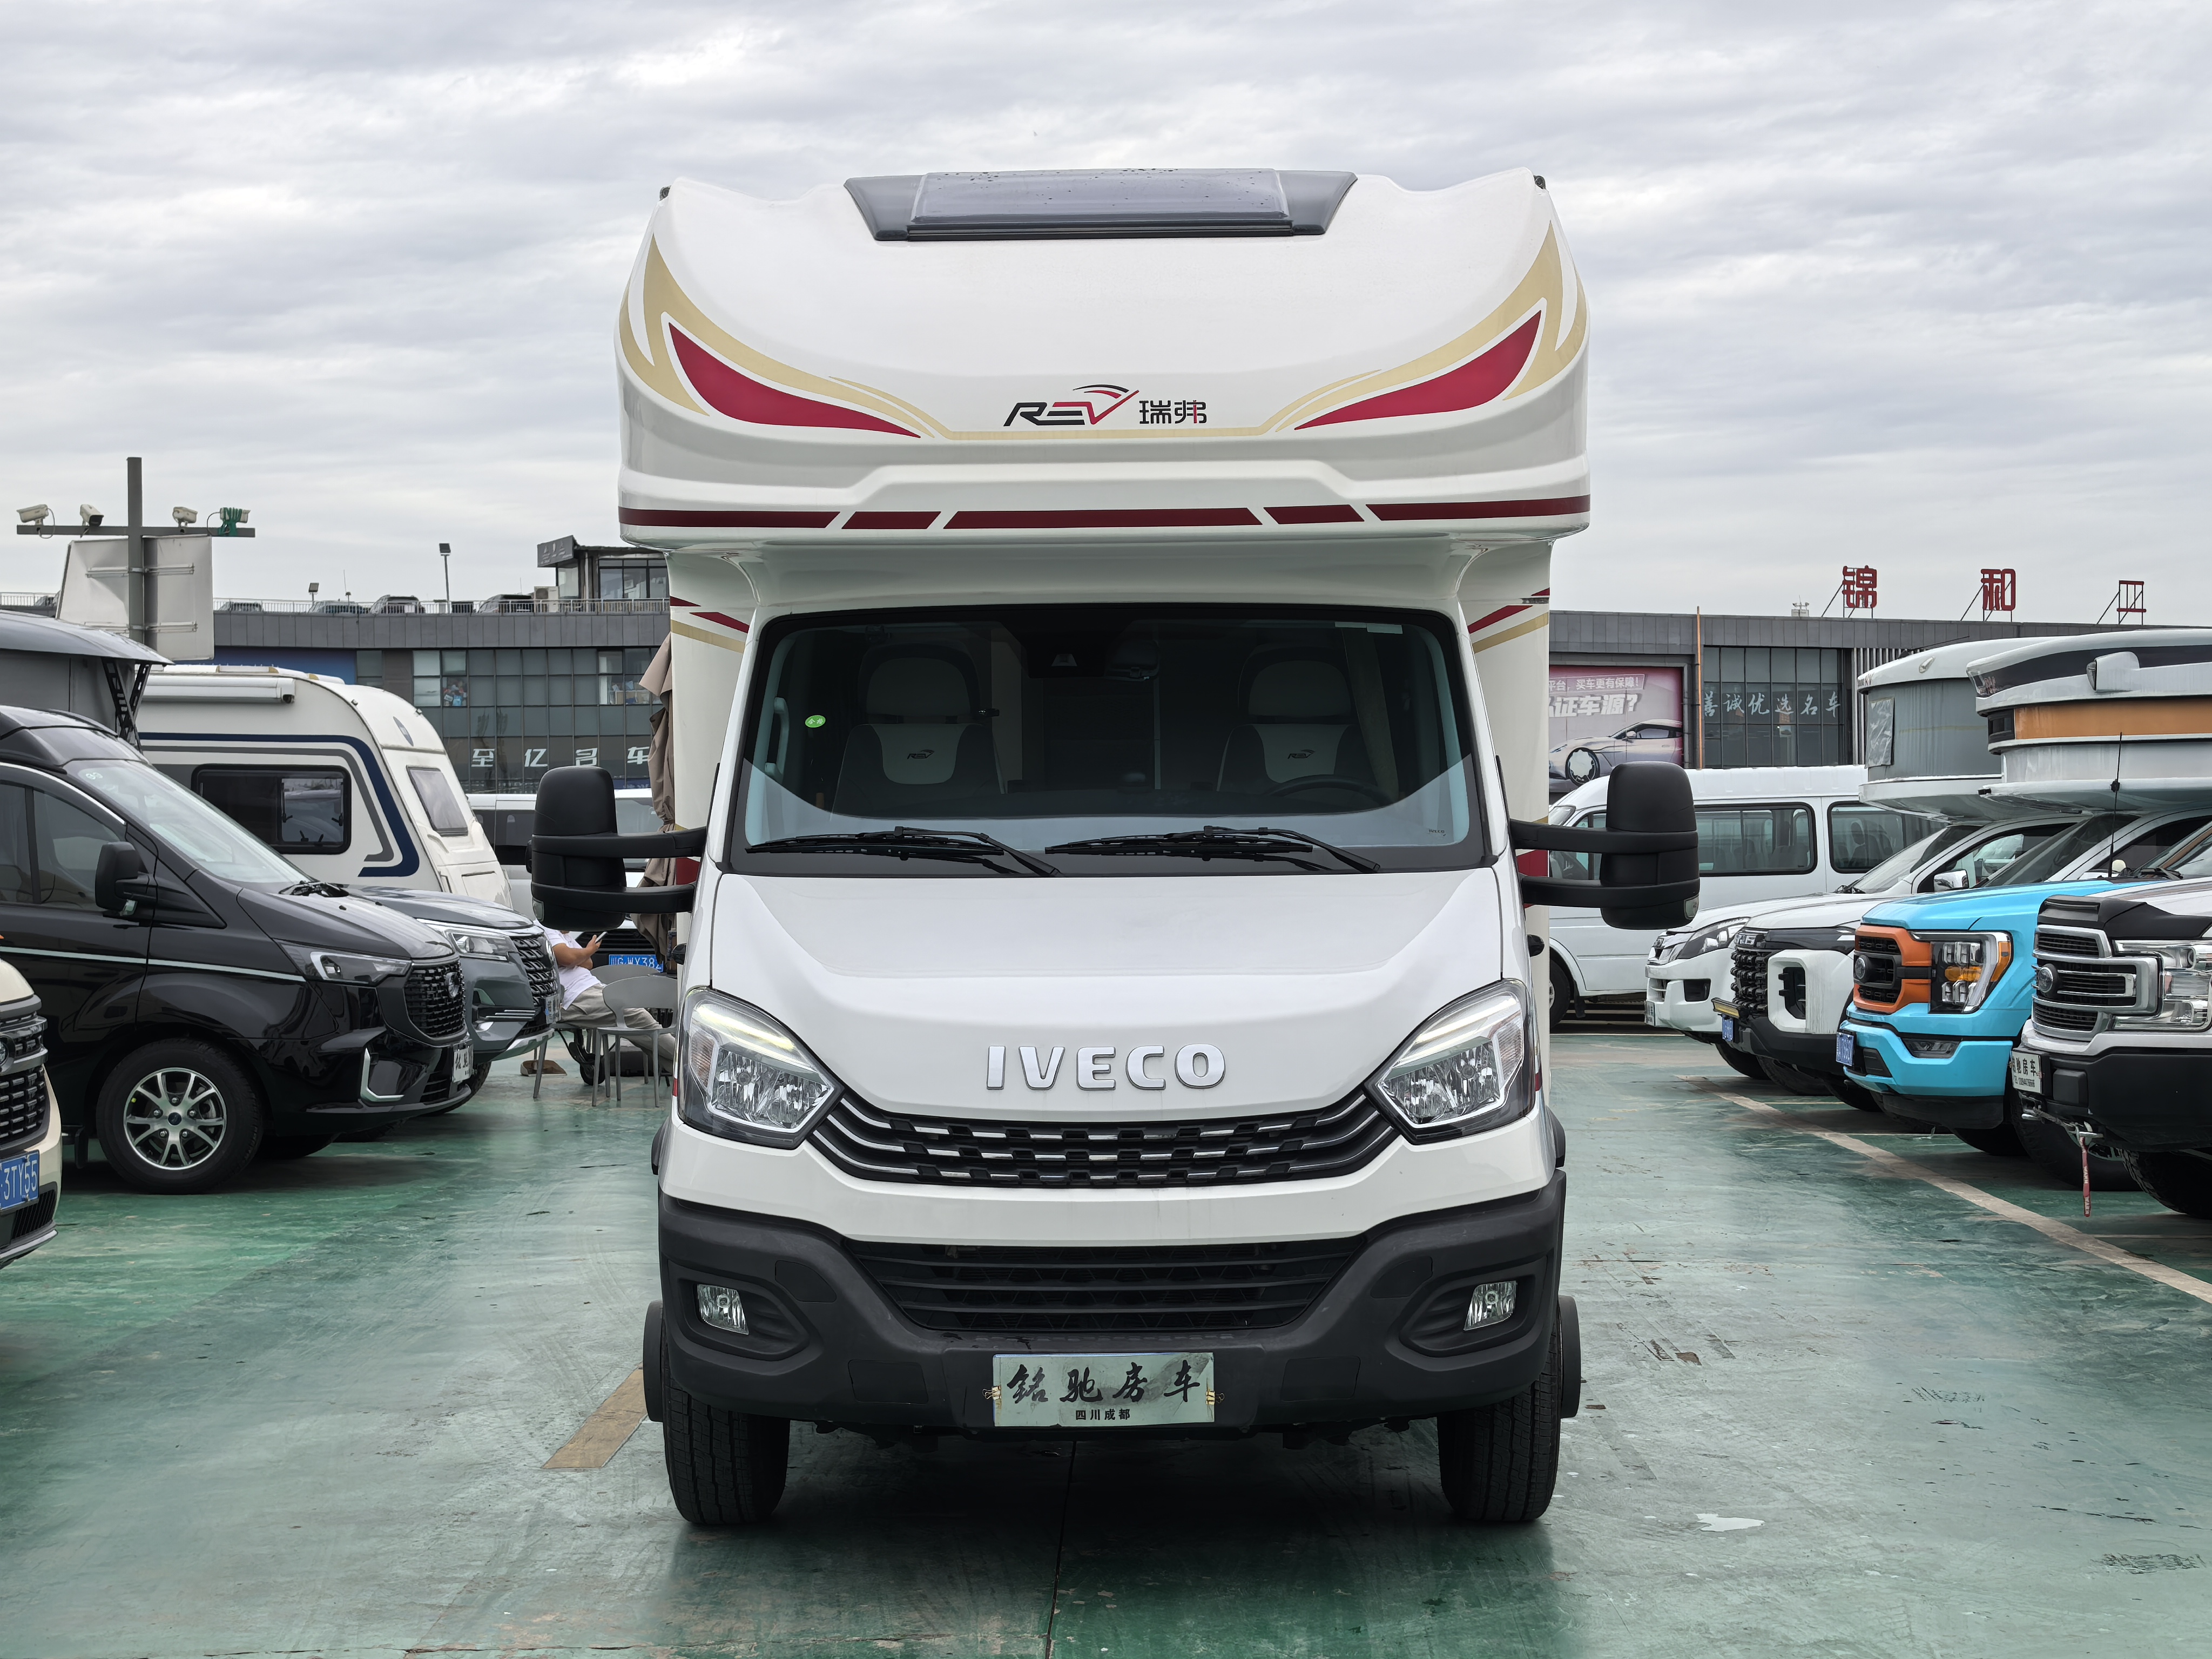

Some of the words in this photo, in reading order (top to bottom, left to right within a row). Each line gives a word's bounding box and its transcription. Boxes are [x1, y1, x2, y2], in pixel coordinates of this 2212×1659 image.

[1003, 389, 1139, 427] REV
[1139, 400, 1207, 424] 瑞弗
[987, 1044, 1225, 1090] IVECO
[1007, 1359, 1201, 1404] 铭驰房车
[1075, 1408, 1130, 1421] 四川成都
